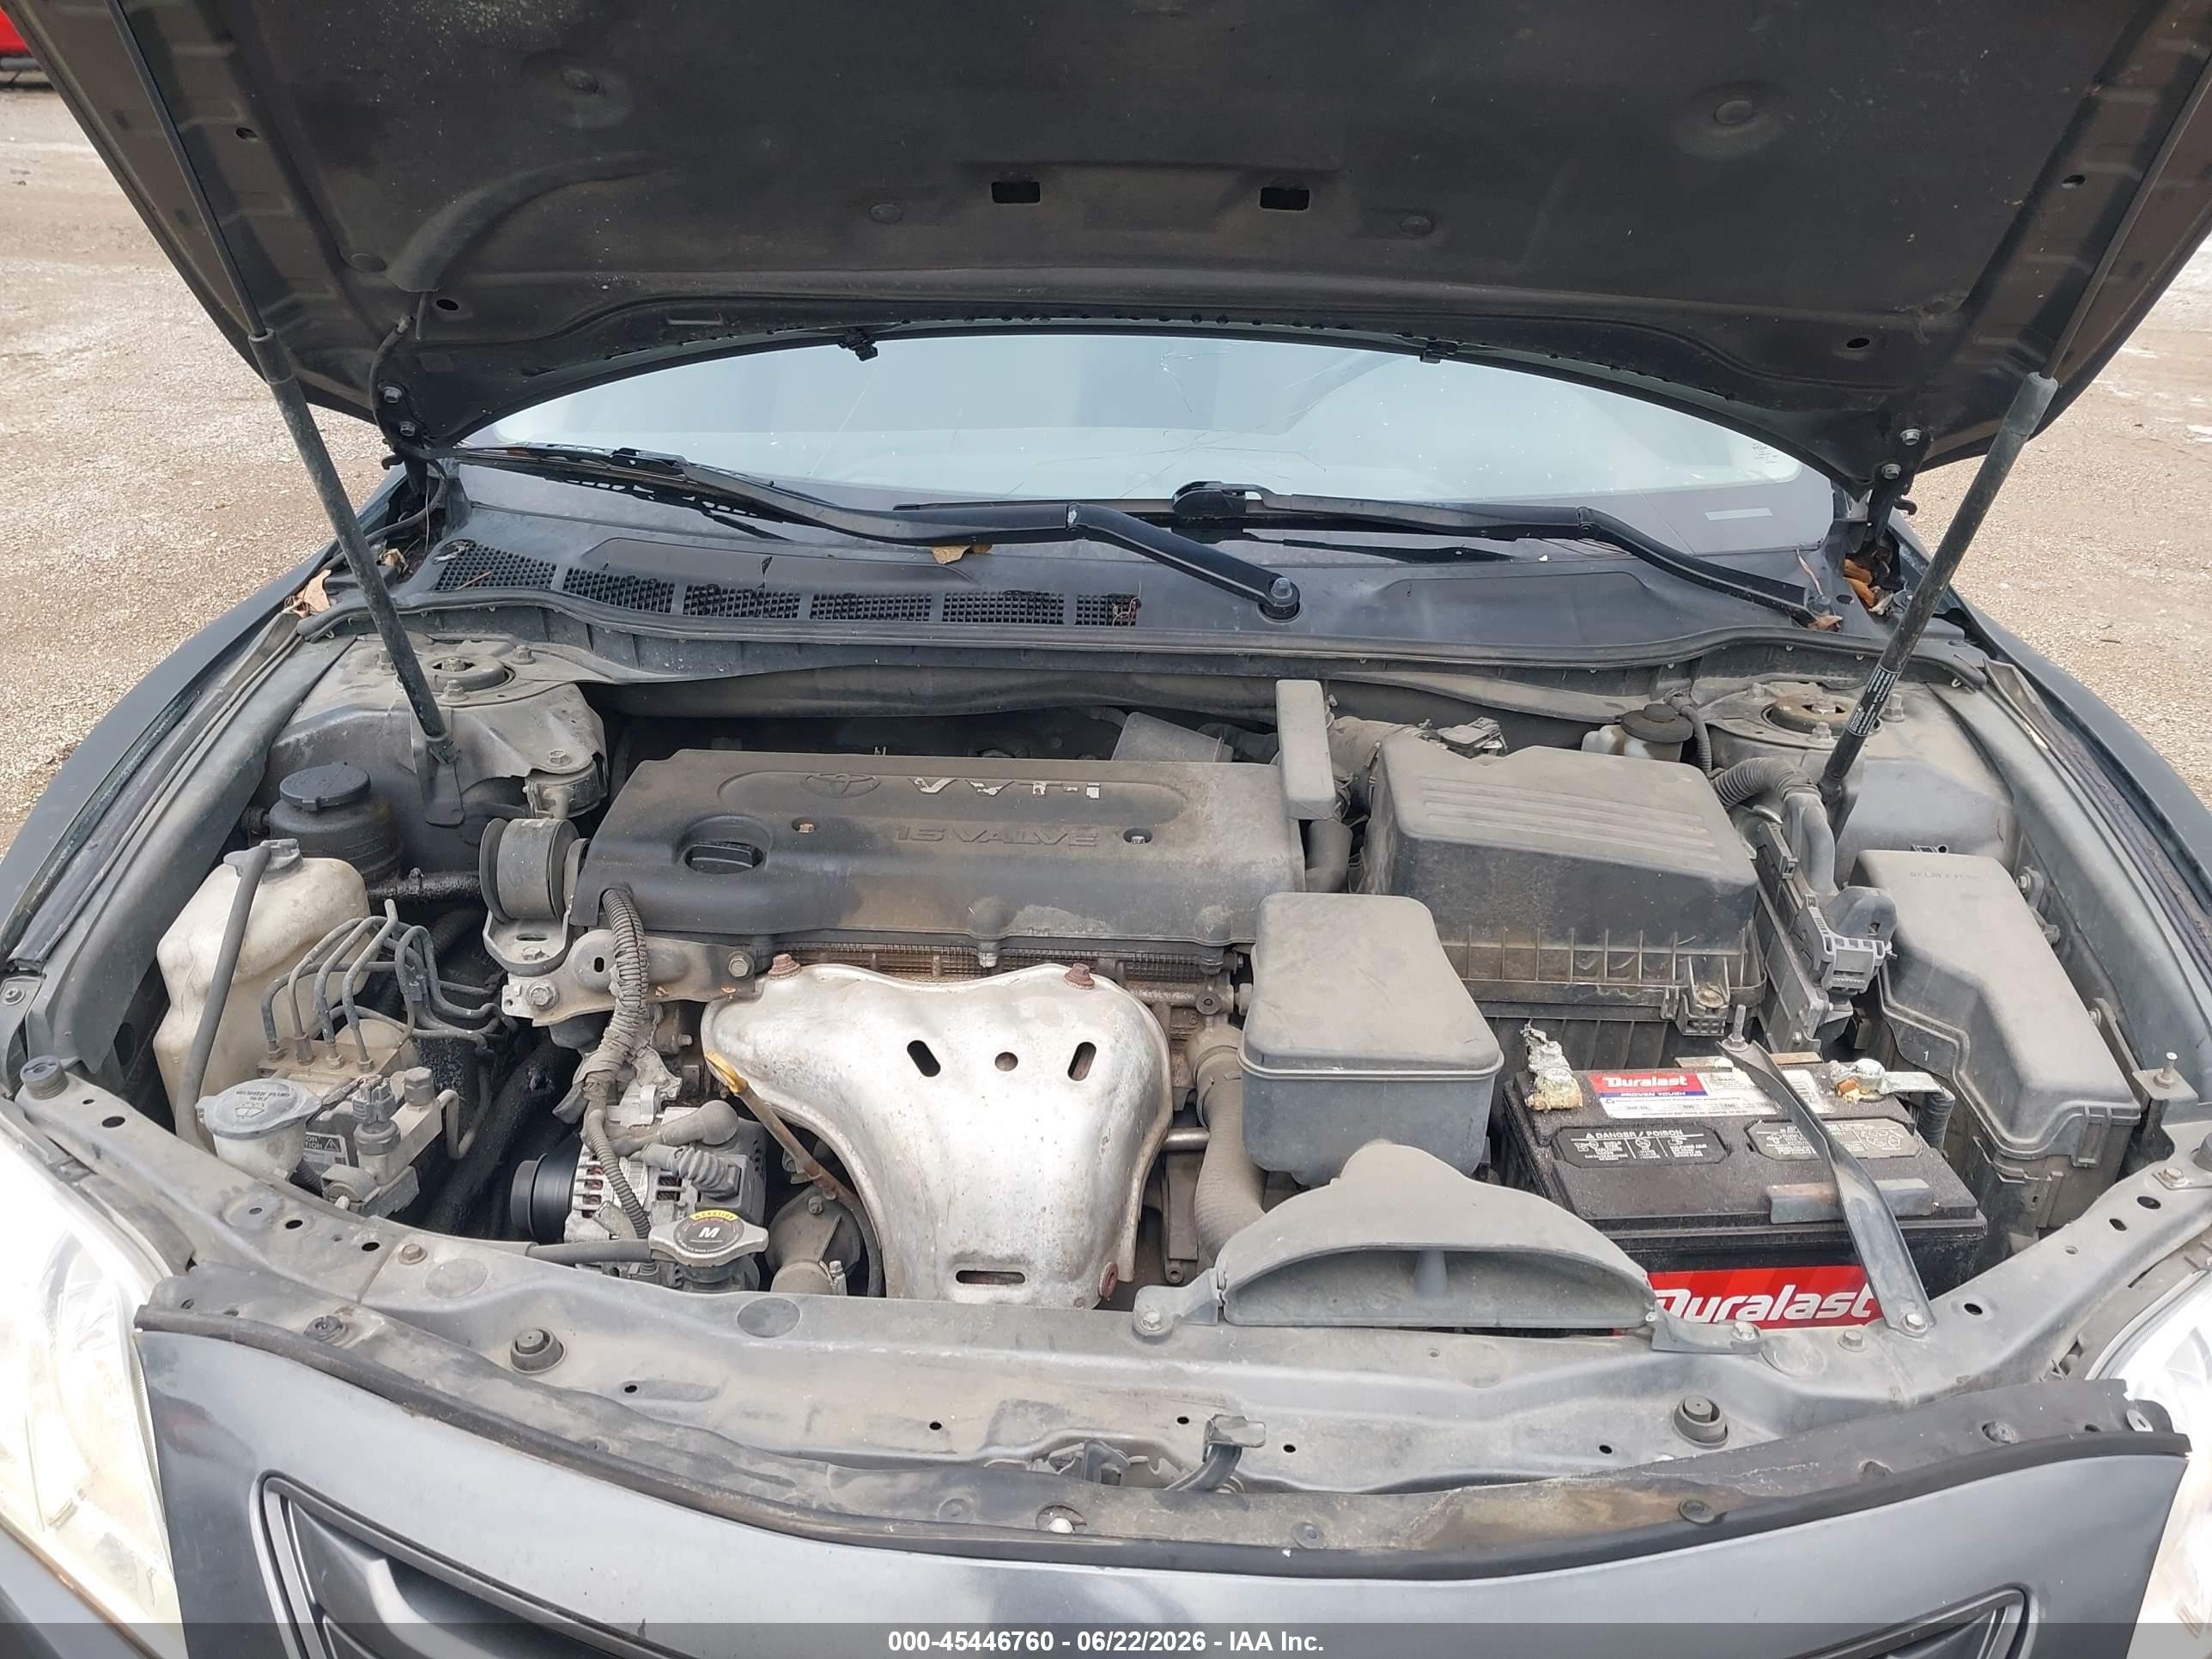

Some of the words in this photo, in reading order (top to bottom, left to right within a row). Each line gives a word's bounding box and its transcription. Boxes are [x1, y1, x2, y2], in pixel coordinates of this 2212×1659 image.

[952, 827, 1098, 848] VALVE
[1603, 1075, 1689, 1088] Duralast
[1595, 1131, 1638, 1139] DANGER
[1645, 1128, 1684, 1138] POISON
[698, 1226, 721, 1238] M
[1653, 1283, 1875, 1324] Duralast
